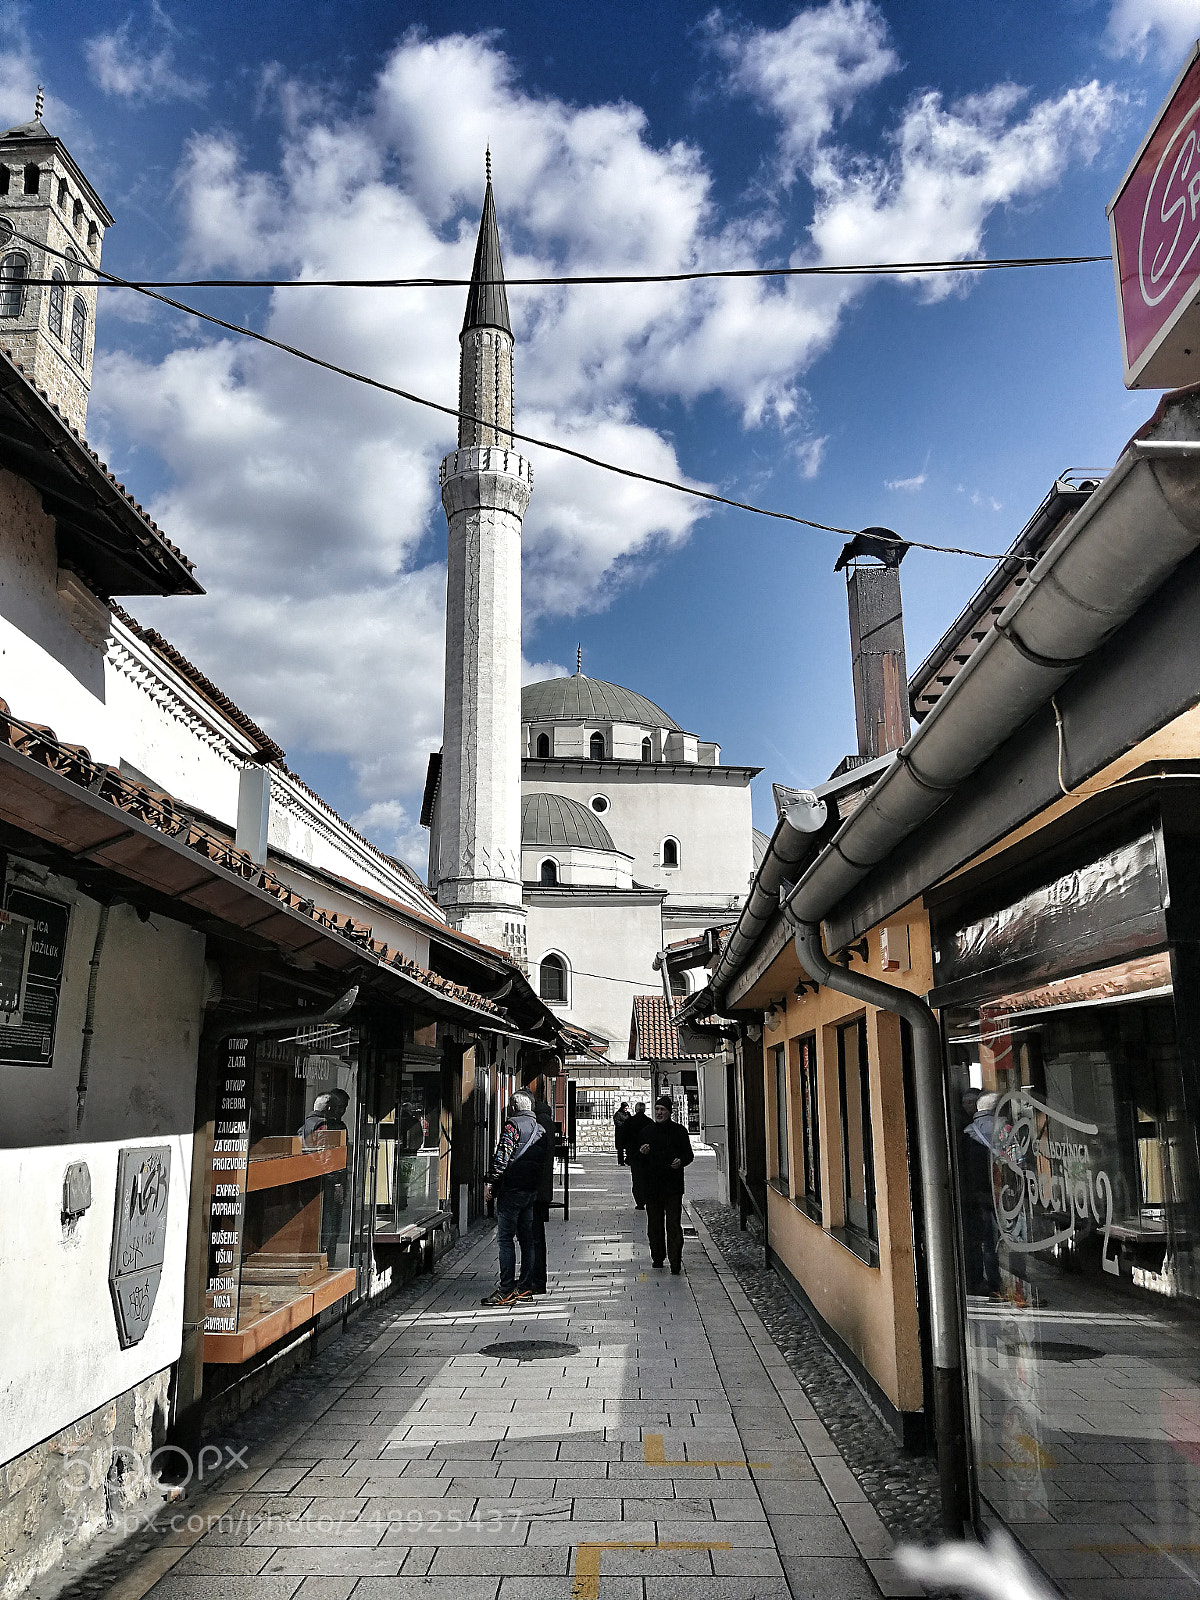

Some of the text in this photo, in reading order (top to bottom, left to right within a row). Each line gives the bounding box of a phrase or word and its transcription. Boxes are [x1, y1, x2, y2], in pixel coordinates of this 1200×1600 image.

[228, 1038, 249, 1050] OTKUP
[227, 1056, 246, 1068] ZLATA
[225, 1079, 246, 1092] OTKUP
[221, 1097, 246, 1110] SREBRA
[218, 1120, 247, 1134] ZAMJENA
[224, 1139, 248, 1152] GOTOVE
[212, 1157, 247, 1171] PROIZVODE
[215, 1183, 241, 1197] EXPRES
[211, 1202, 242, 1216] POPRAVCI
[211, 1229, 239, 1245] BUŠENJE
[213, 1295, 231, 1309] NOSA
